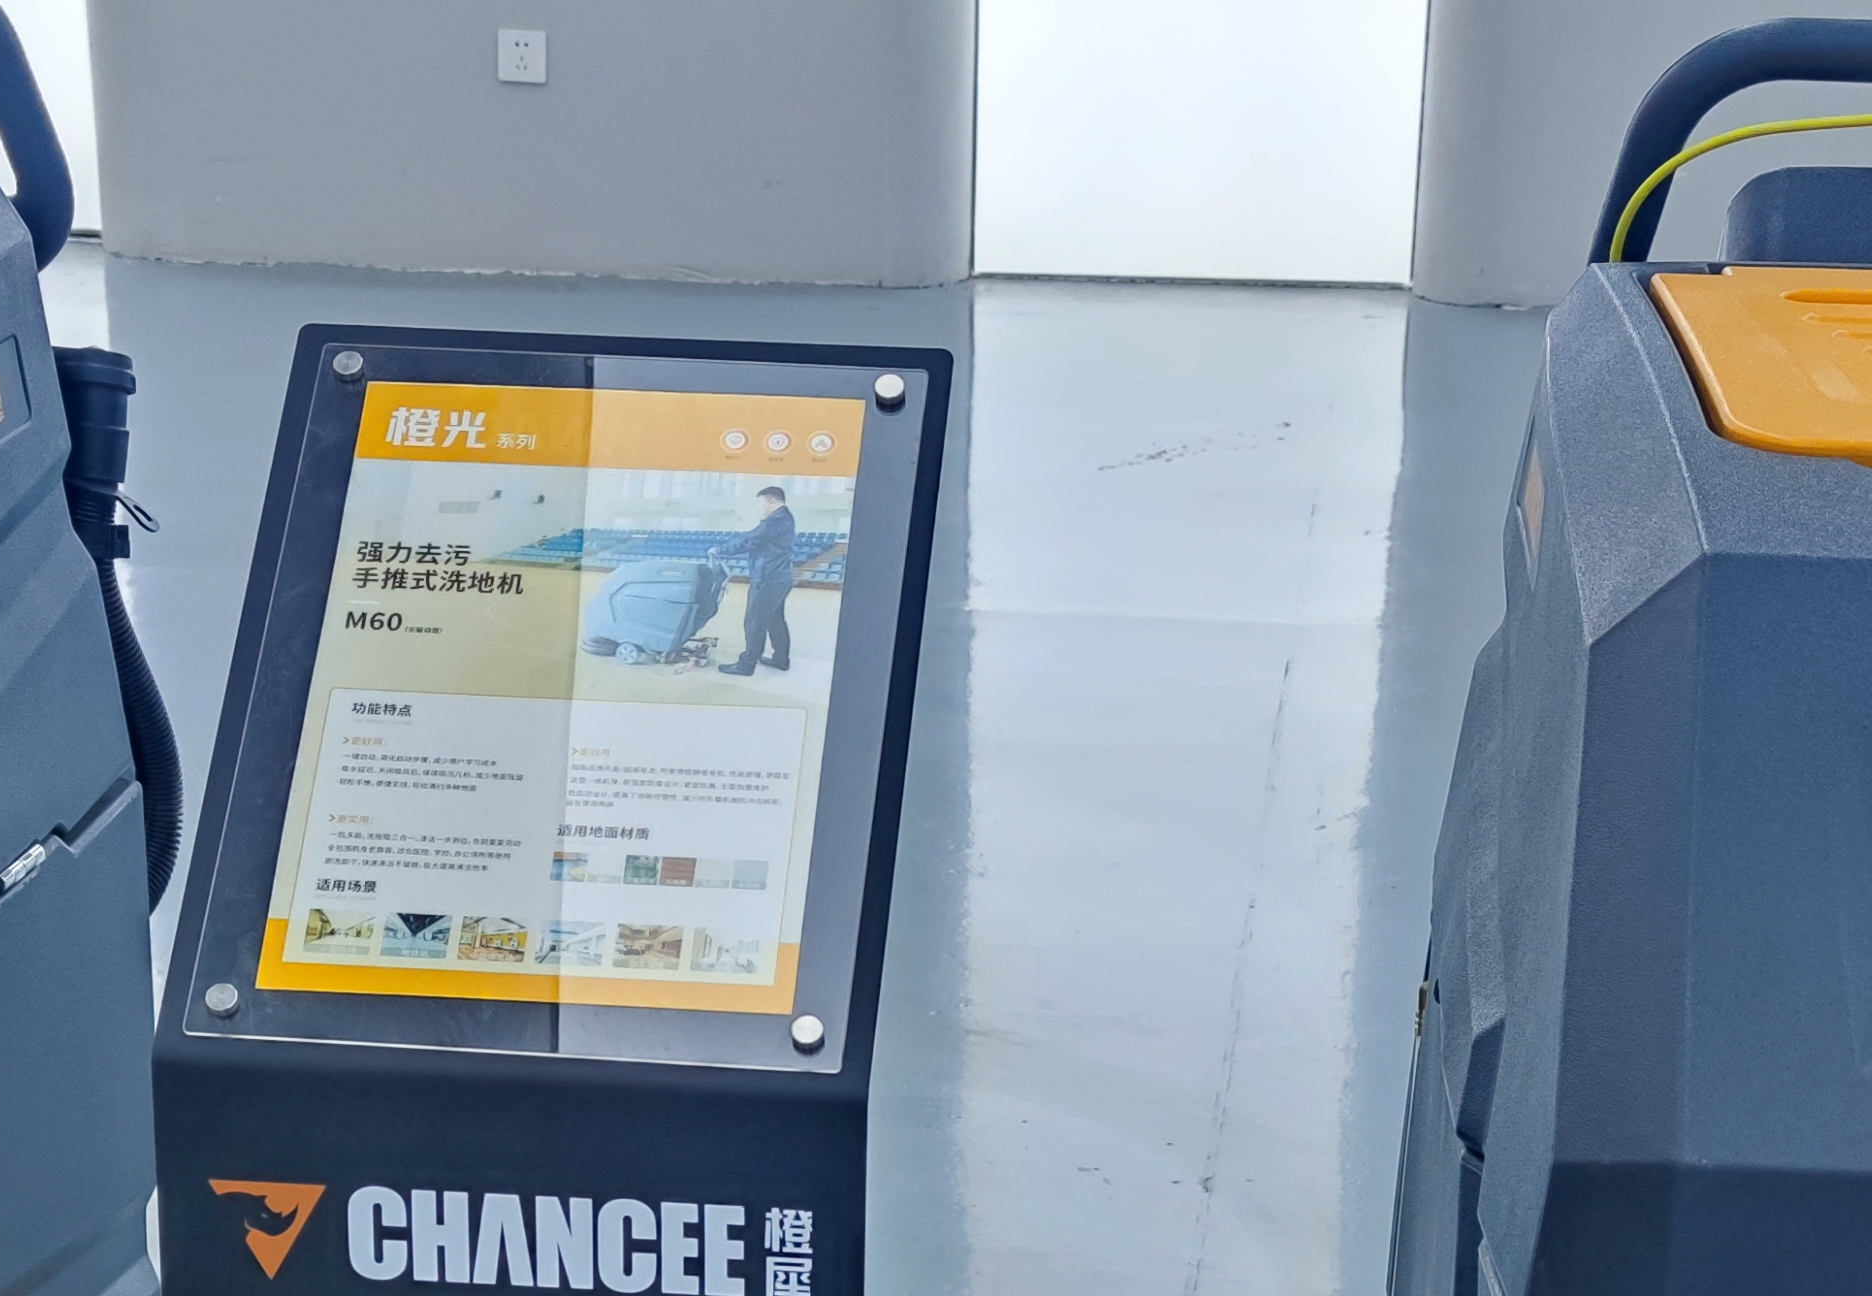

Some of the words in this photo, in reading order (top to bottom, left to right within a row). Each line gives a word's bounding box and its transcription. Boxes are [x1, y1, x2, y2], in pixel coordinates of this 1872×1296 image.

[384, 406, 487, 449] 橙光
[495, 432, 537, 451] 系列
[355, 540, 472, 566] 强力去污
[351, 566, 524, 595] 手推式洗地机
[344, 610, 404, 632] M60
[350, 701, 413, 718] 功能特点
[556, 823, 650, 841] 适用地面材质
[315, 877, 378, 894] 适用场景
